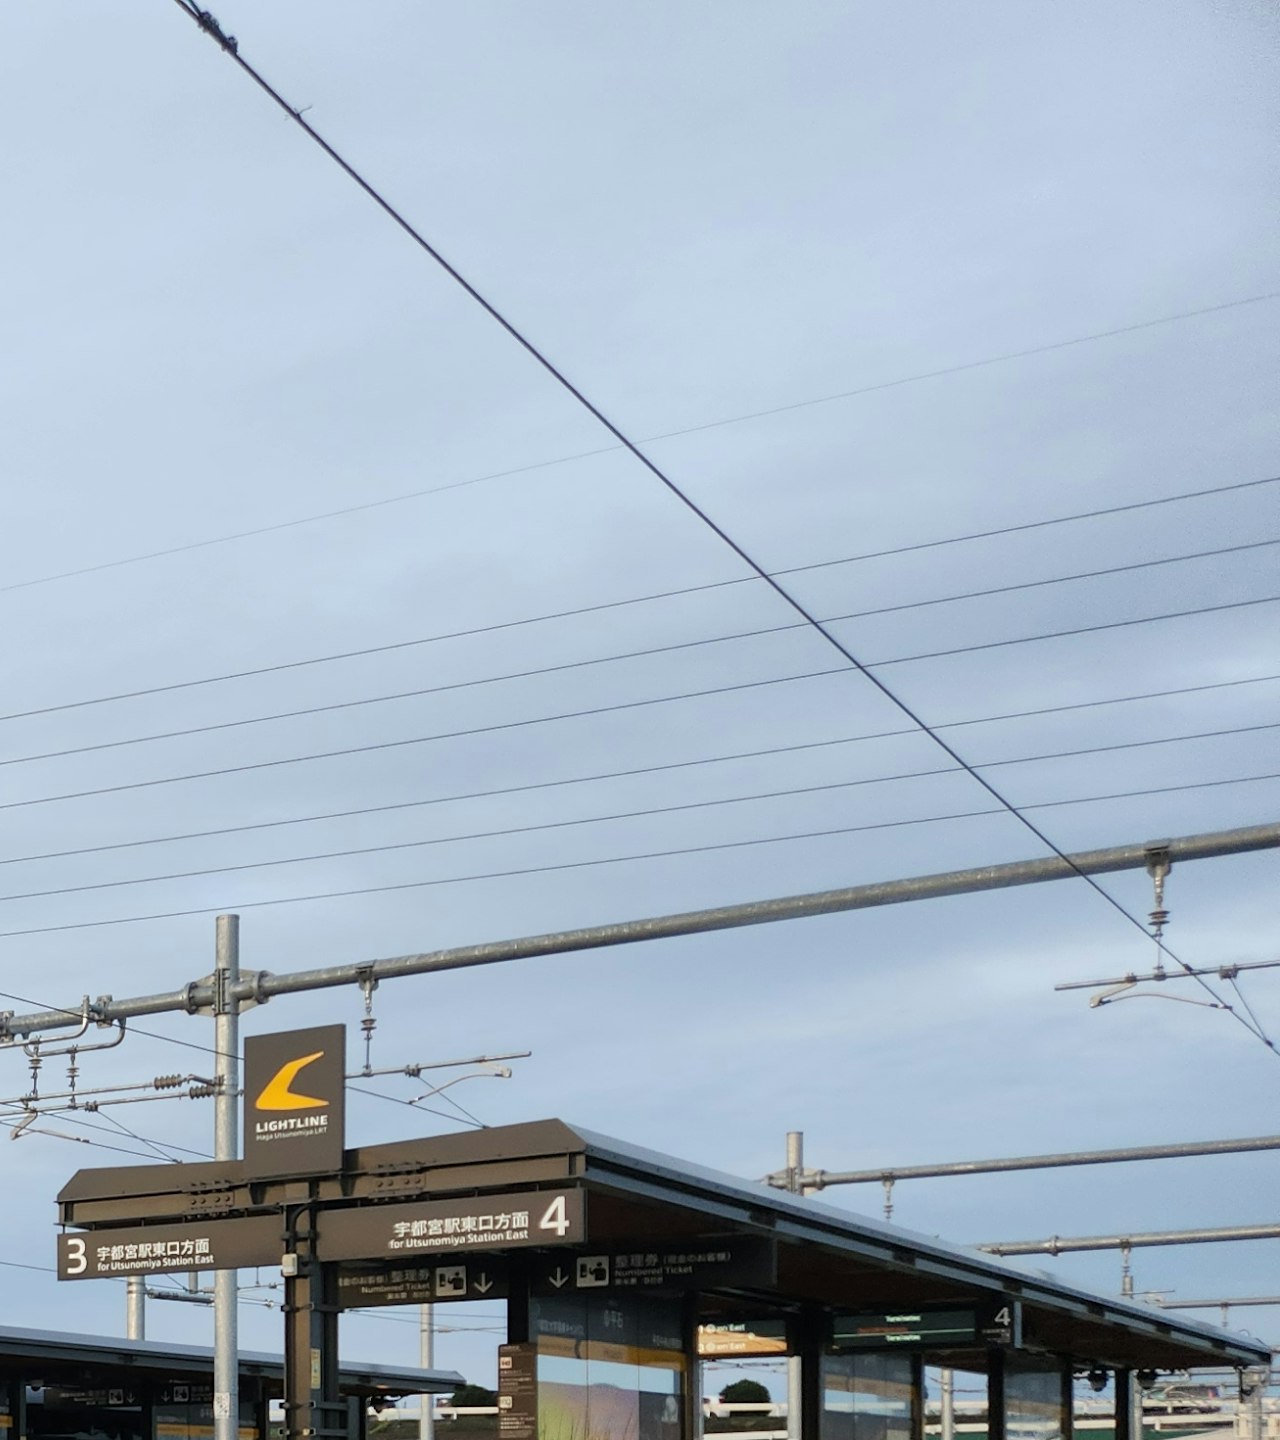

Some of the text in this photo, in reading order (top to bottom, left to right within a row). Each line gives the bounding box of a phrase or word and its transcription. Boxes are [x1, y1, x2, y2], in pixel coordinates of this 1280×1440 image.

[256, 1115, 328, 1133] LIGHTLINE
[393, 1211, 529, 1238] 宇都宮駅東口方面
[540, 1196, 570, 1236] 4
[389, 1229, 529, 1249] for Utsunomiya Station East
[67, 1238, 88, 1274] 3
[97, 1238, 210, 1261] 宇都宮駅東口方面
[97, 1254, 214, 1272] for Utsunomiya Station East
[615, 1265, 693, 1277] Numbered Ticket
[362, 1282, 431, 1294] Numbered Ticket
[994, 1307, 1011, 1326] 4
